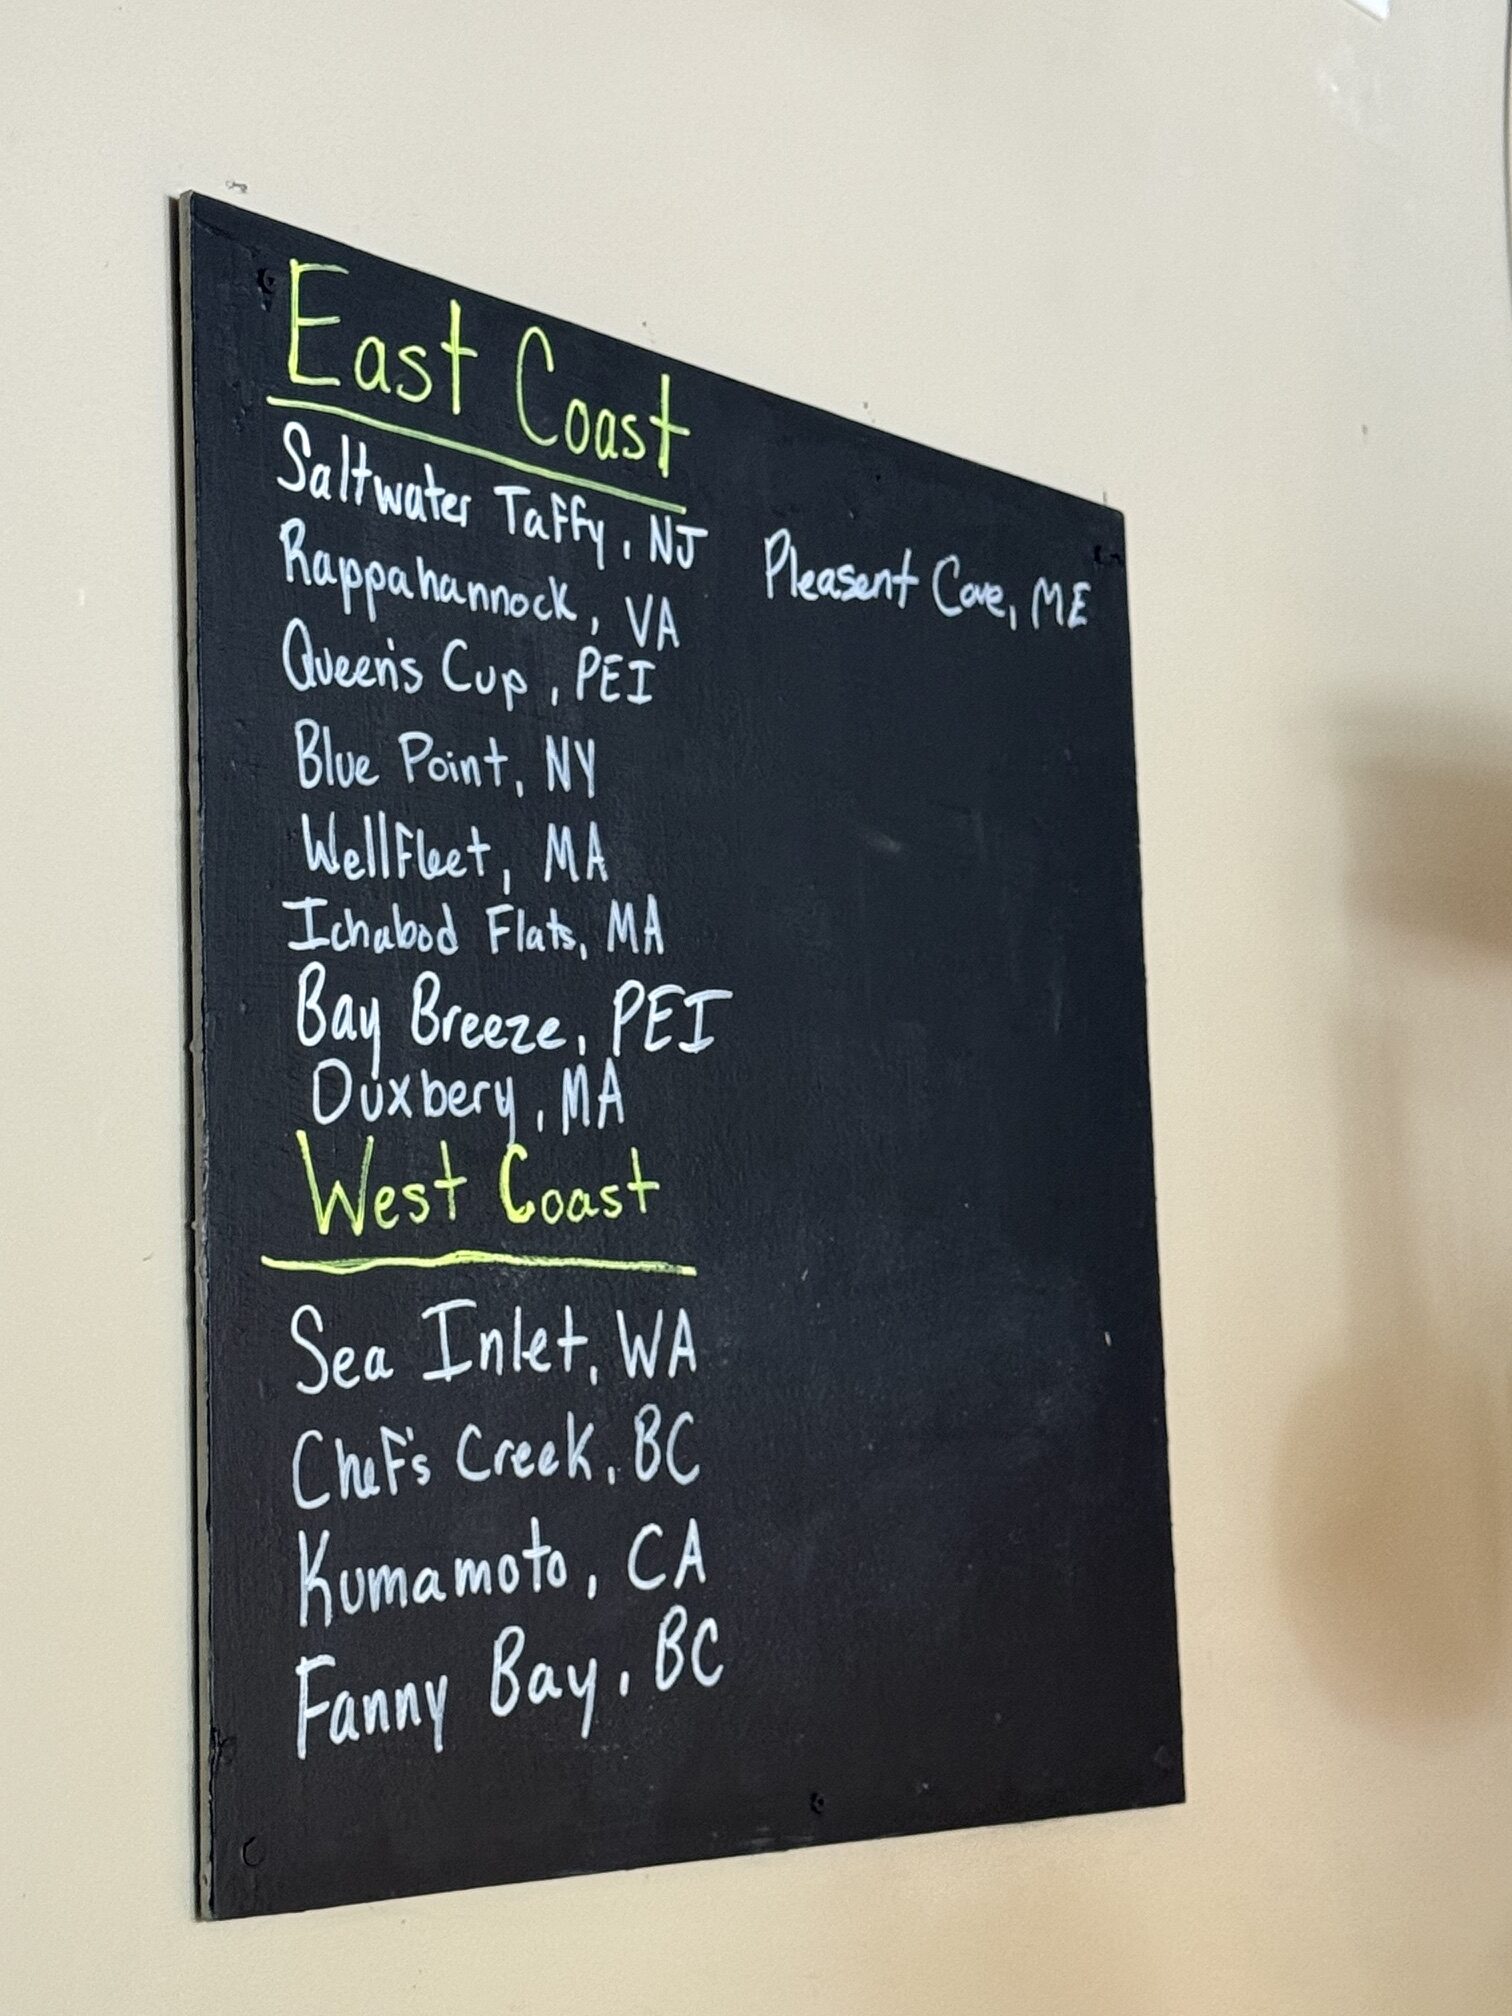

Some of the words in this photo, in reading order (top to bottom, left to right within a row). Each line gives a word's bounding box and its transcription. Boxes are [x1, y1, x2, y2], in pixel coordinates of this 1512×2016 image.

[285, 258, 479, 416] East
[515, 325, 691, 479] Coast
[276, 420, 473, 528] Saltwater
[649, 513, 709, 570] NJ
[278, 517, 600, 636] Rappahannock,
[624, 587, 681, 652] VA
[763, 527, 920, 609] Pleasent
[1031, 576, 1092, 630] ME
[281, 617, 424, 695] Queen's
[575, 645, 656, 706] PEI
[293, 717, 380, 790] Blue
[397, 730, 525, 799] Point,
[545, 734, 596, 799] NY
[543, 820, 609, 883] MA
[281, 896, 459, 956] Ichabod
[485, 903, 589, 961] Flats,
[606, 893, 666, 956] MA
[296, 960, 381, 1081] Bay
[410, 970, 588, 1057] Breeze,
[611, 979, 735, 1057] PEI
[561, 1056, 626, 1136] MA
[295, 1129, 468, 1237] West
[499, 1142, 661, 1225] Coast
[290, 1304, 395, 1396] Sea
[420, 1298, 600, 1387] Inlet,
[615, 1308, 698, 1380] WA
[455, 1409, 617, 1488] Creek,
[633, 1402, 701, 1487] BC
[297, 1515, 599, 1629] Kumamoto,
[626, 1516, 708, 1591] CA
[294, 1652, 449, 1761] Fanny
[653, 1603, 725, 1693] BC
